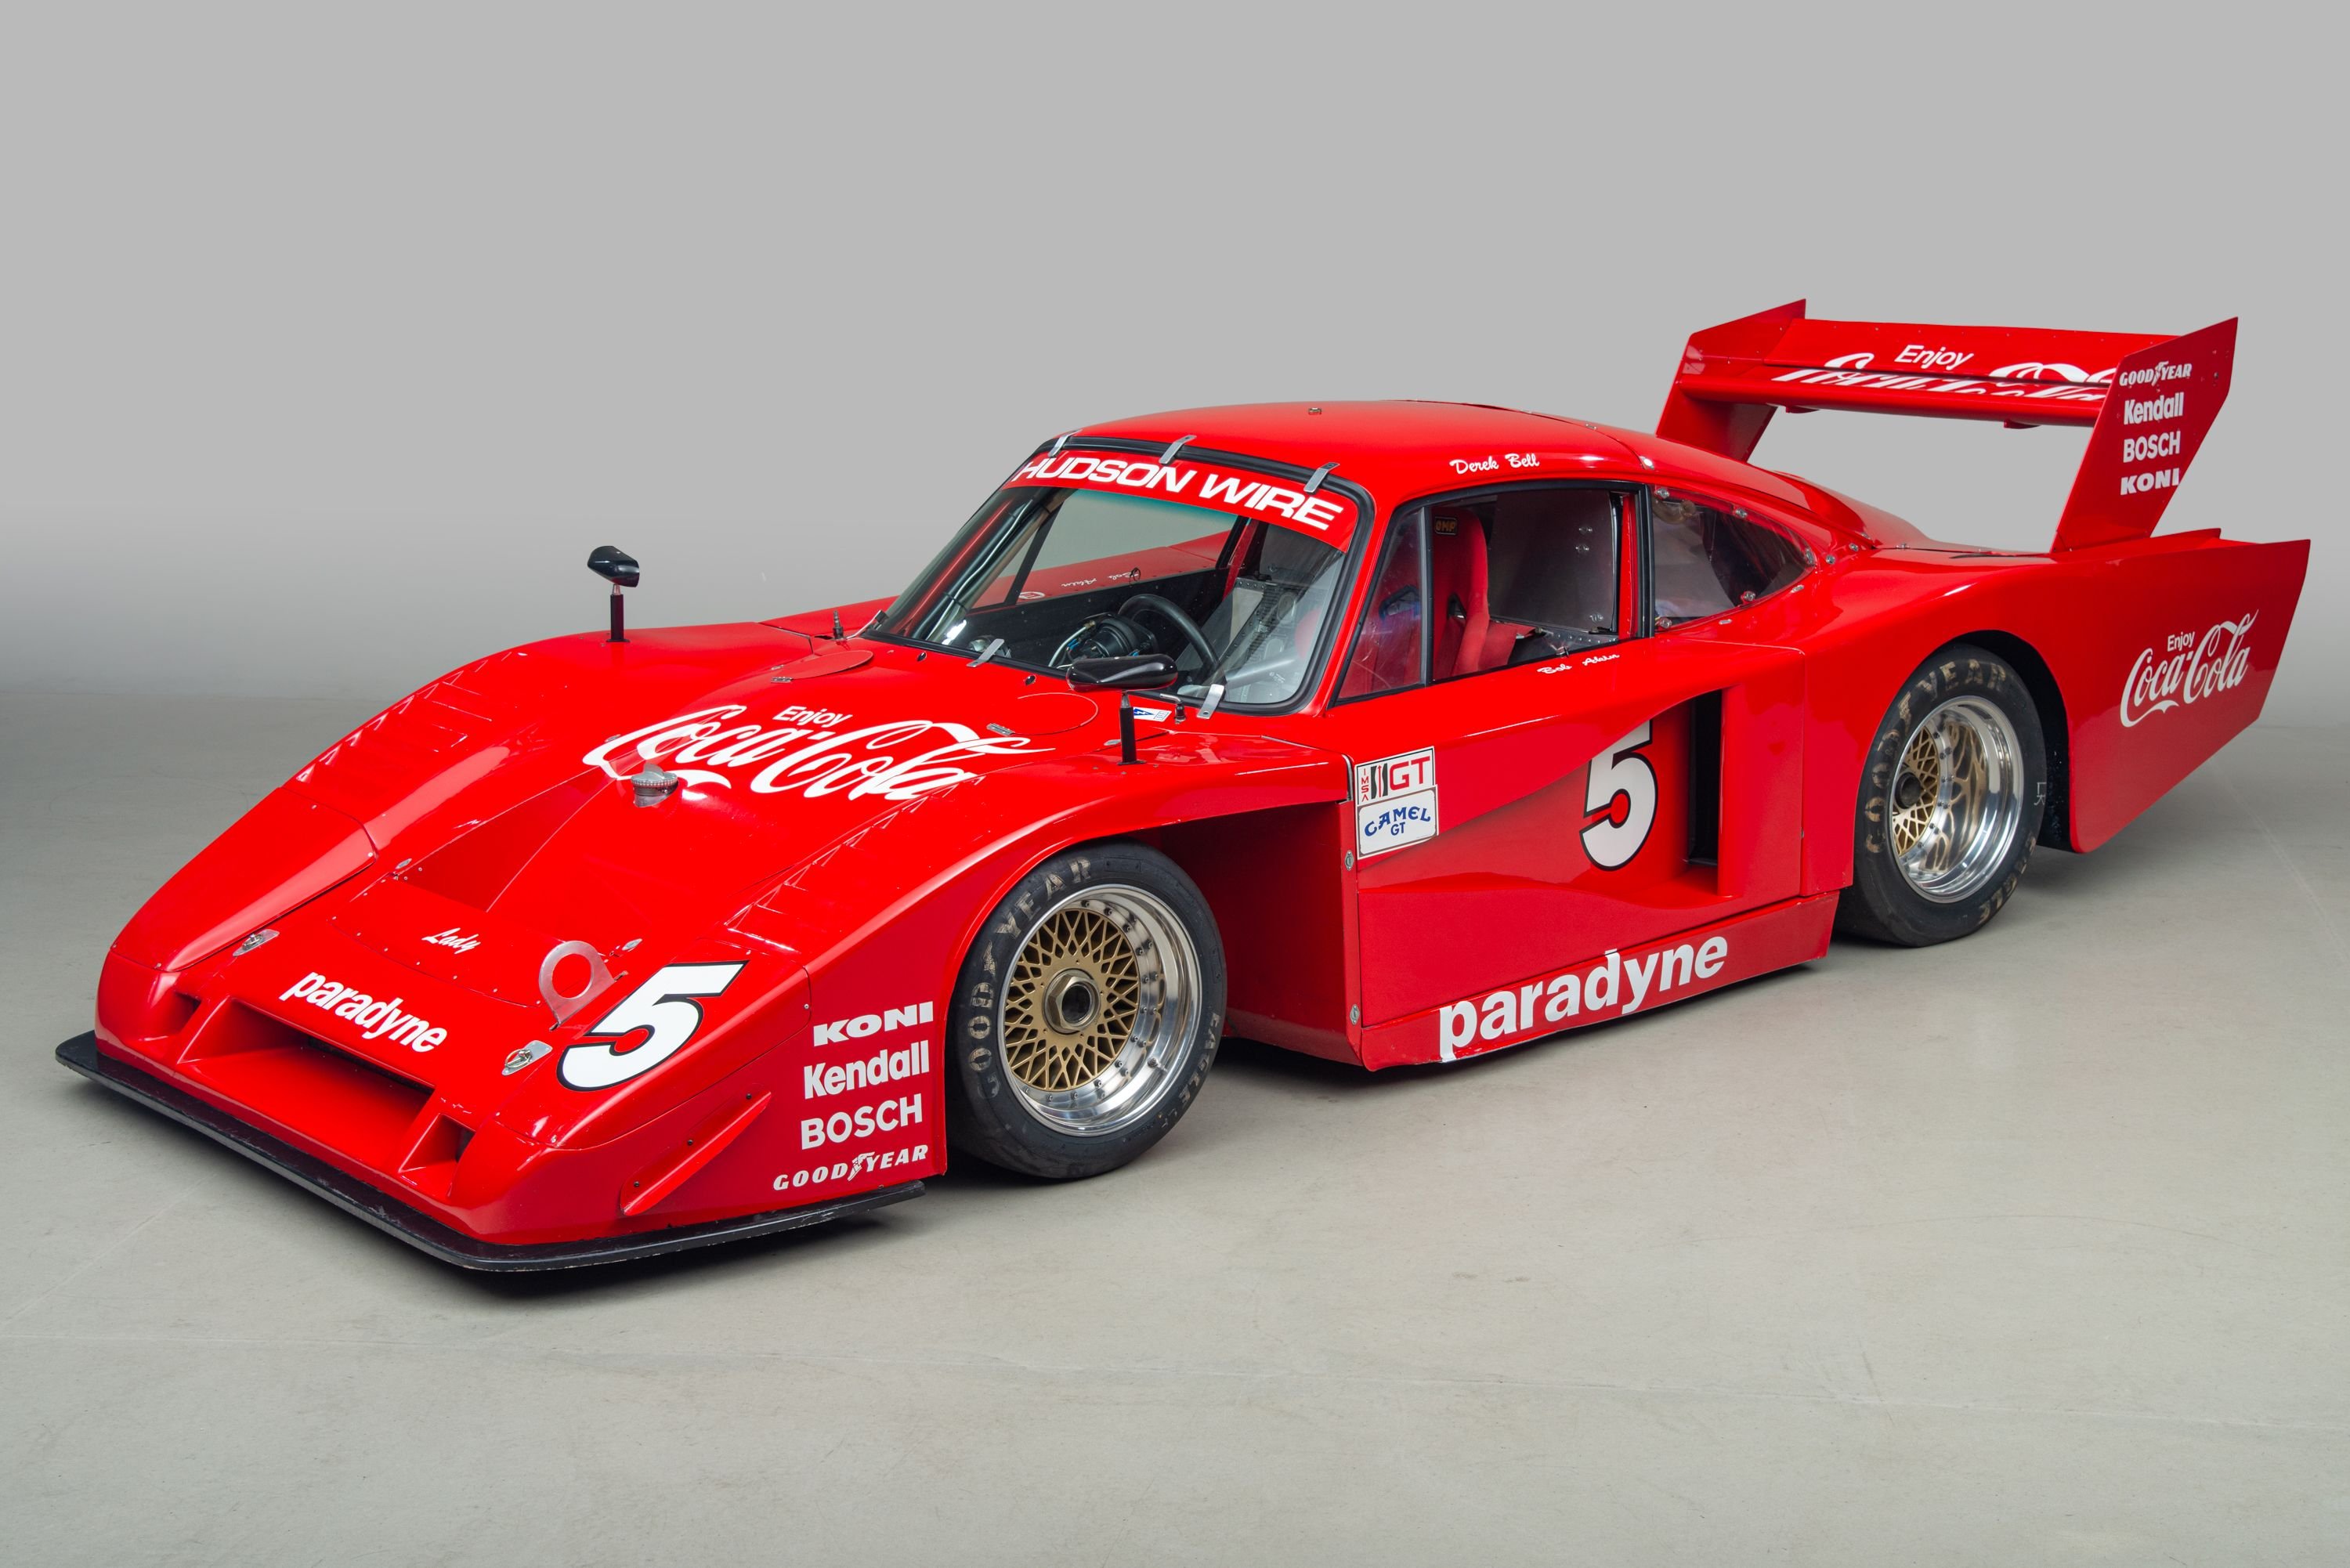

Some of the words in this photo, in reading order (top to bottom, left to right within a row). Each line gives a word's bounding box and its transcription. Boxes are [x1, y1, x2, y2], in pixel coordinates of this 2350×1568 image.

[1894, 344, 1975, 371] Enjoy
[2119, 360, 2193, 387] GOODYEAR
[2124, 392, 2185, 425] Kendall
[2123, 430, 2181, 463] BOSCH
[1449, 456, 1499, 475] Derek
[1505, 453, 1540, 468] Bell
[1012, 457, 1196, 493] HUDSON
[1198, 473, 1344, 531] WIRE
[2120, 468, 2180, 496] KONI
[2167, 631, 2196, 652] Enjoy
[2120, 609, 2259, 728] Coca-Cola
[772, 705, 853, 728] Enjoy
[582, 704, 1057, 801] Coca-Cola
[1390, 756, 1430, 790] GT
[1579, 720, 1659, 872] 5
[1365, 806, 1431, 836] CAMEL
[1390, 822, 1405, 836] GT
[421, 927, 481, 954] Lady
[279, 972, 447, 1053] paradyne
[1439, 937, 1728, 1062] paradyne
[556, 959, 750, 1092] 5
[813, 1001, 934, 1047] KONI
[804, 1039, 930, 1100] Kendall
[801, 1093, 923, 1150] BOSCH
[772, 1144, 929, 1191] GOODYEAR
